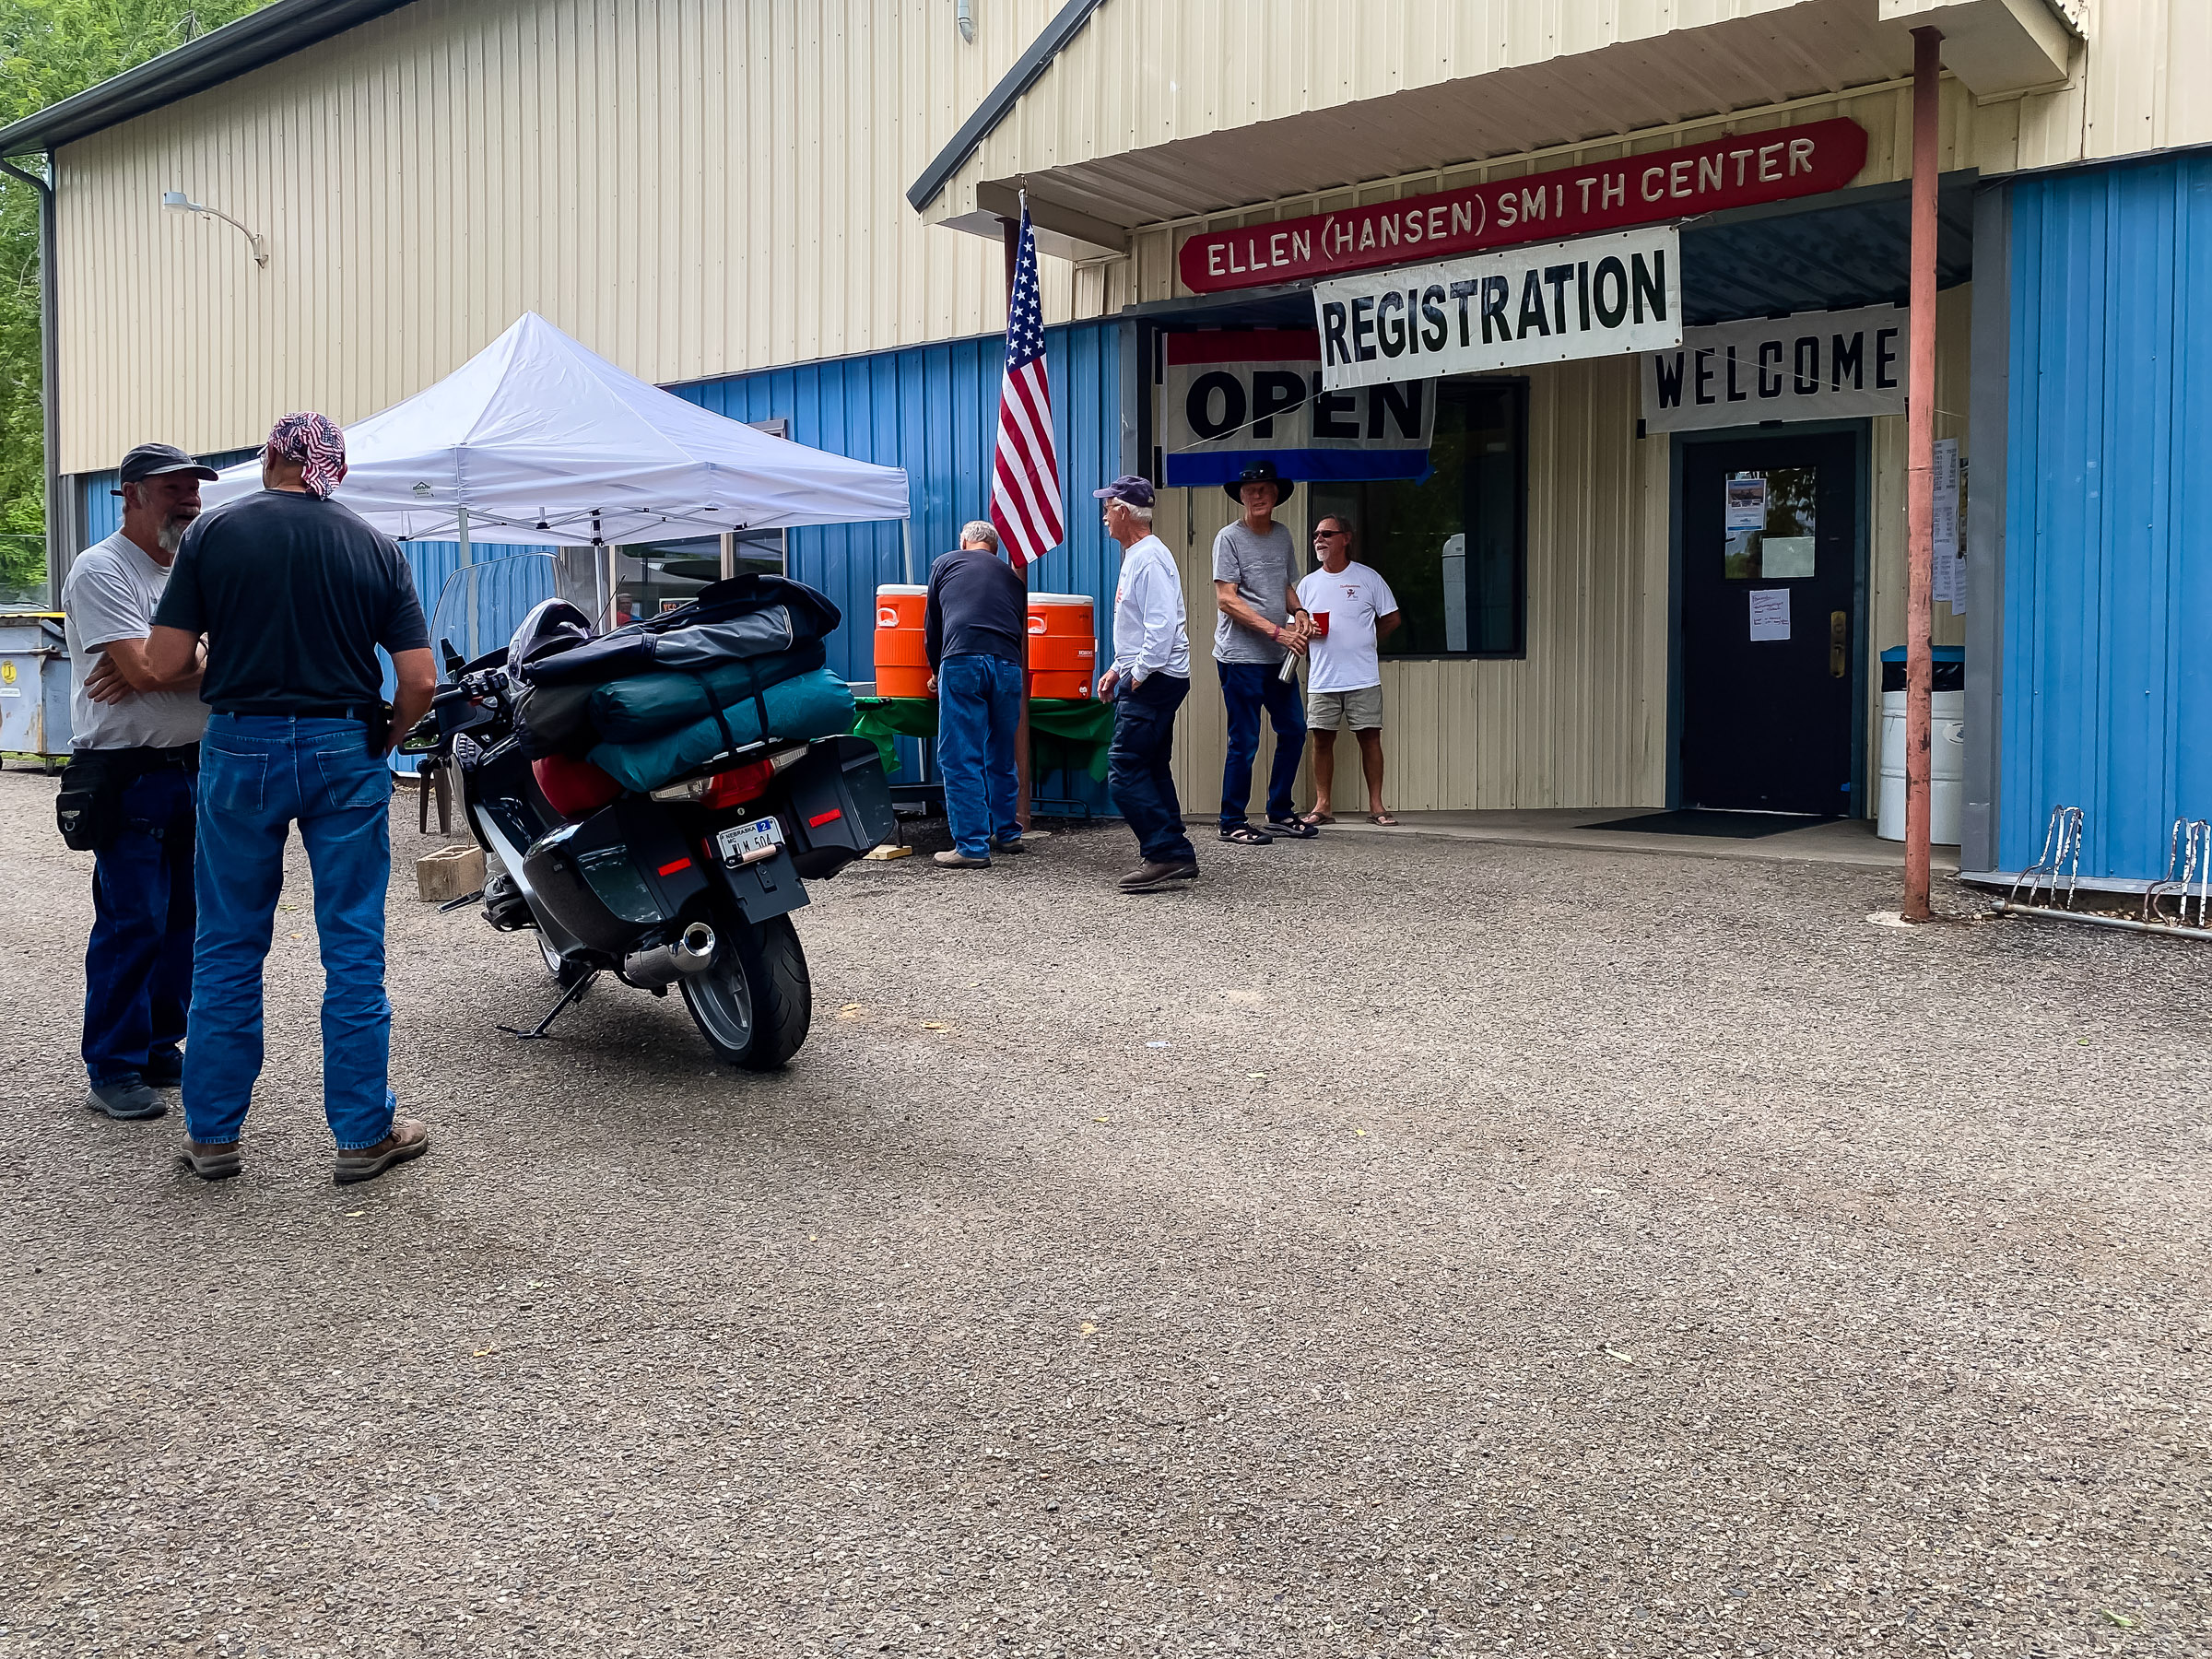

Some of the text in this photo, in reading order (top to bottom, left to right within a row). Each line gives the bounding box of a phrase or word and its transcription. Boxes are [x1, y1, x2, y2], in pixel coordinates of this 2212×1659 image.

[1207, 138, 1815, 276] ELLEN (HANSEN) SMITH CENTER
[1323, 250, 1667, 367] REGISTRATION
[1185, 371, 1423, 441] OPEN
[1655, 327, 1899, 409] WELCOME
[725, 822, 768, 839] NEBRASKA 2
